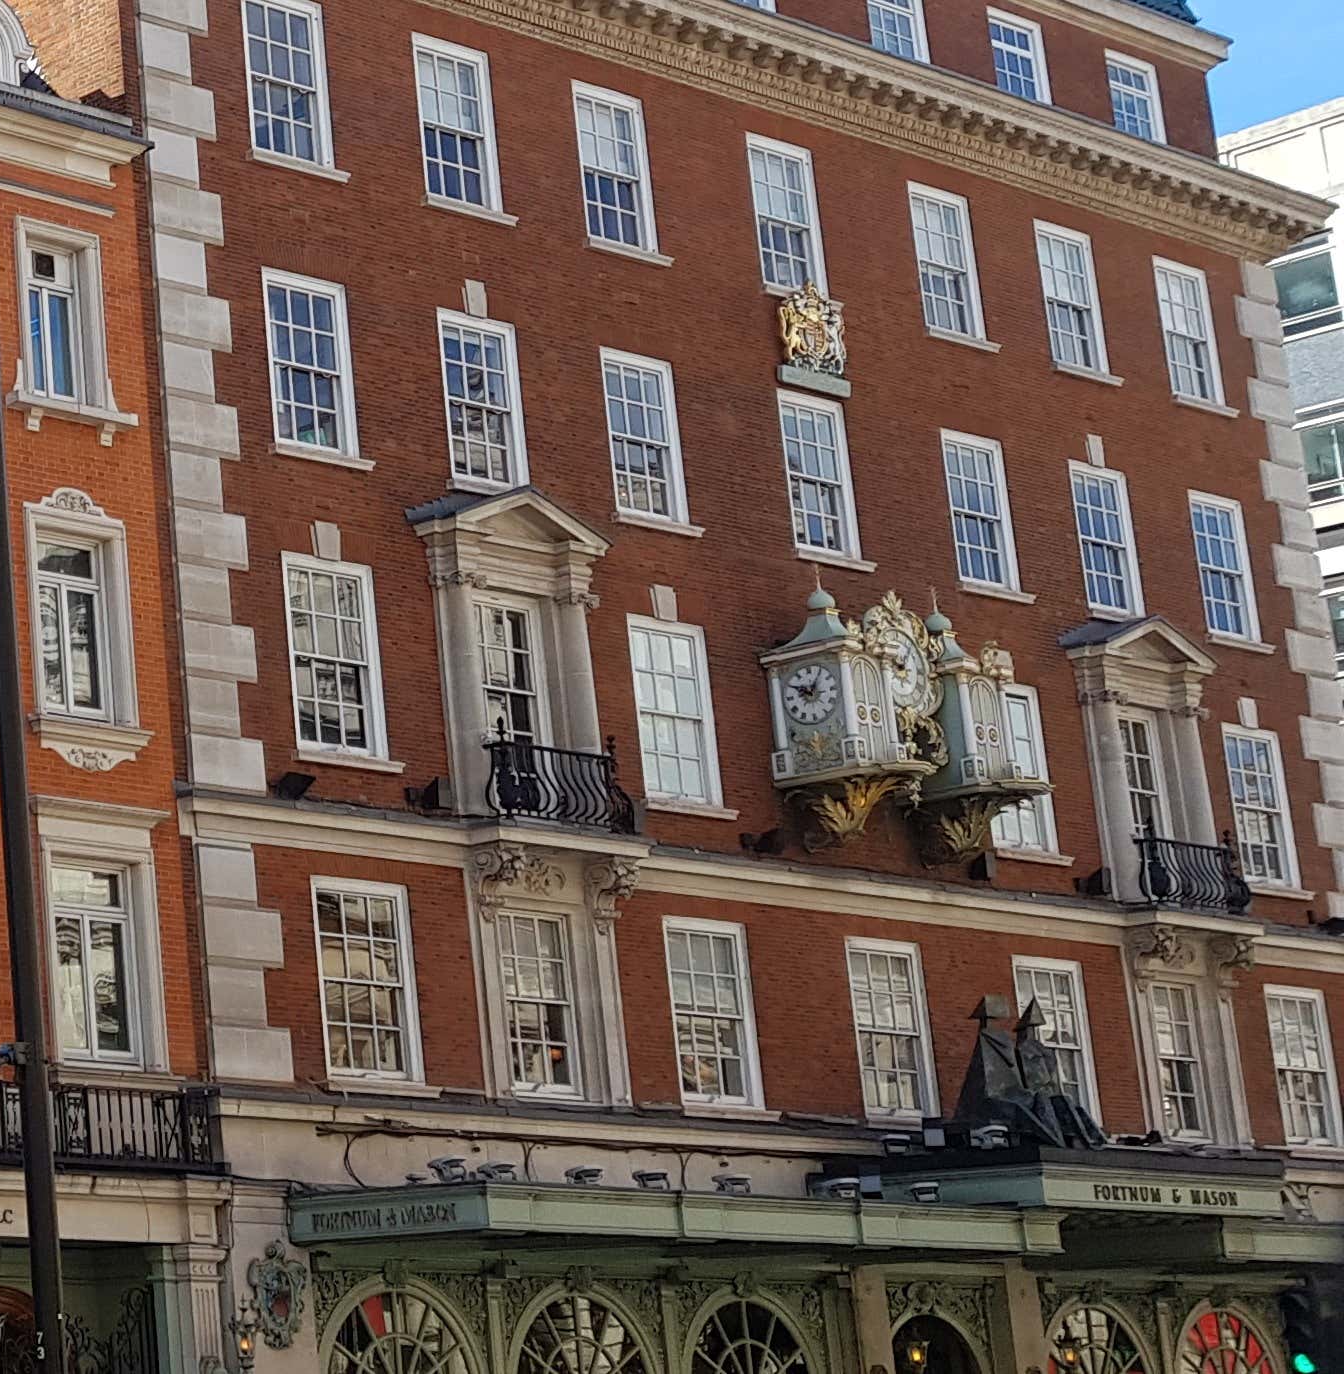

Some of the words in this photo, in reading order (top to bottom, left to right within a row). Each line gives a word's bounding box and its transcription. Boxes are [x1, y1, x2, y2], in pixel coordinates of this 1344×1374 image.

[1094, 1184, 1162, 1203] FORTNUM
[1172, 1188, 1182, 1204] &
[1189, 1189, 1239, 1206] MASON
